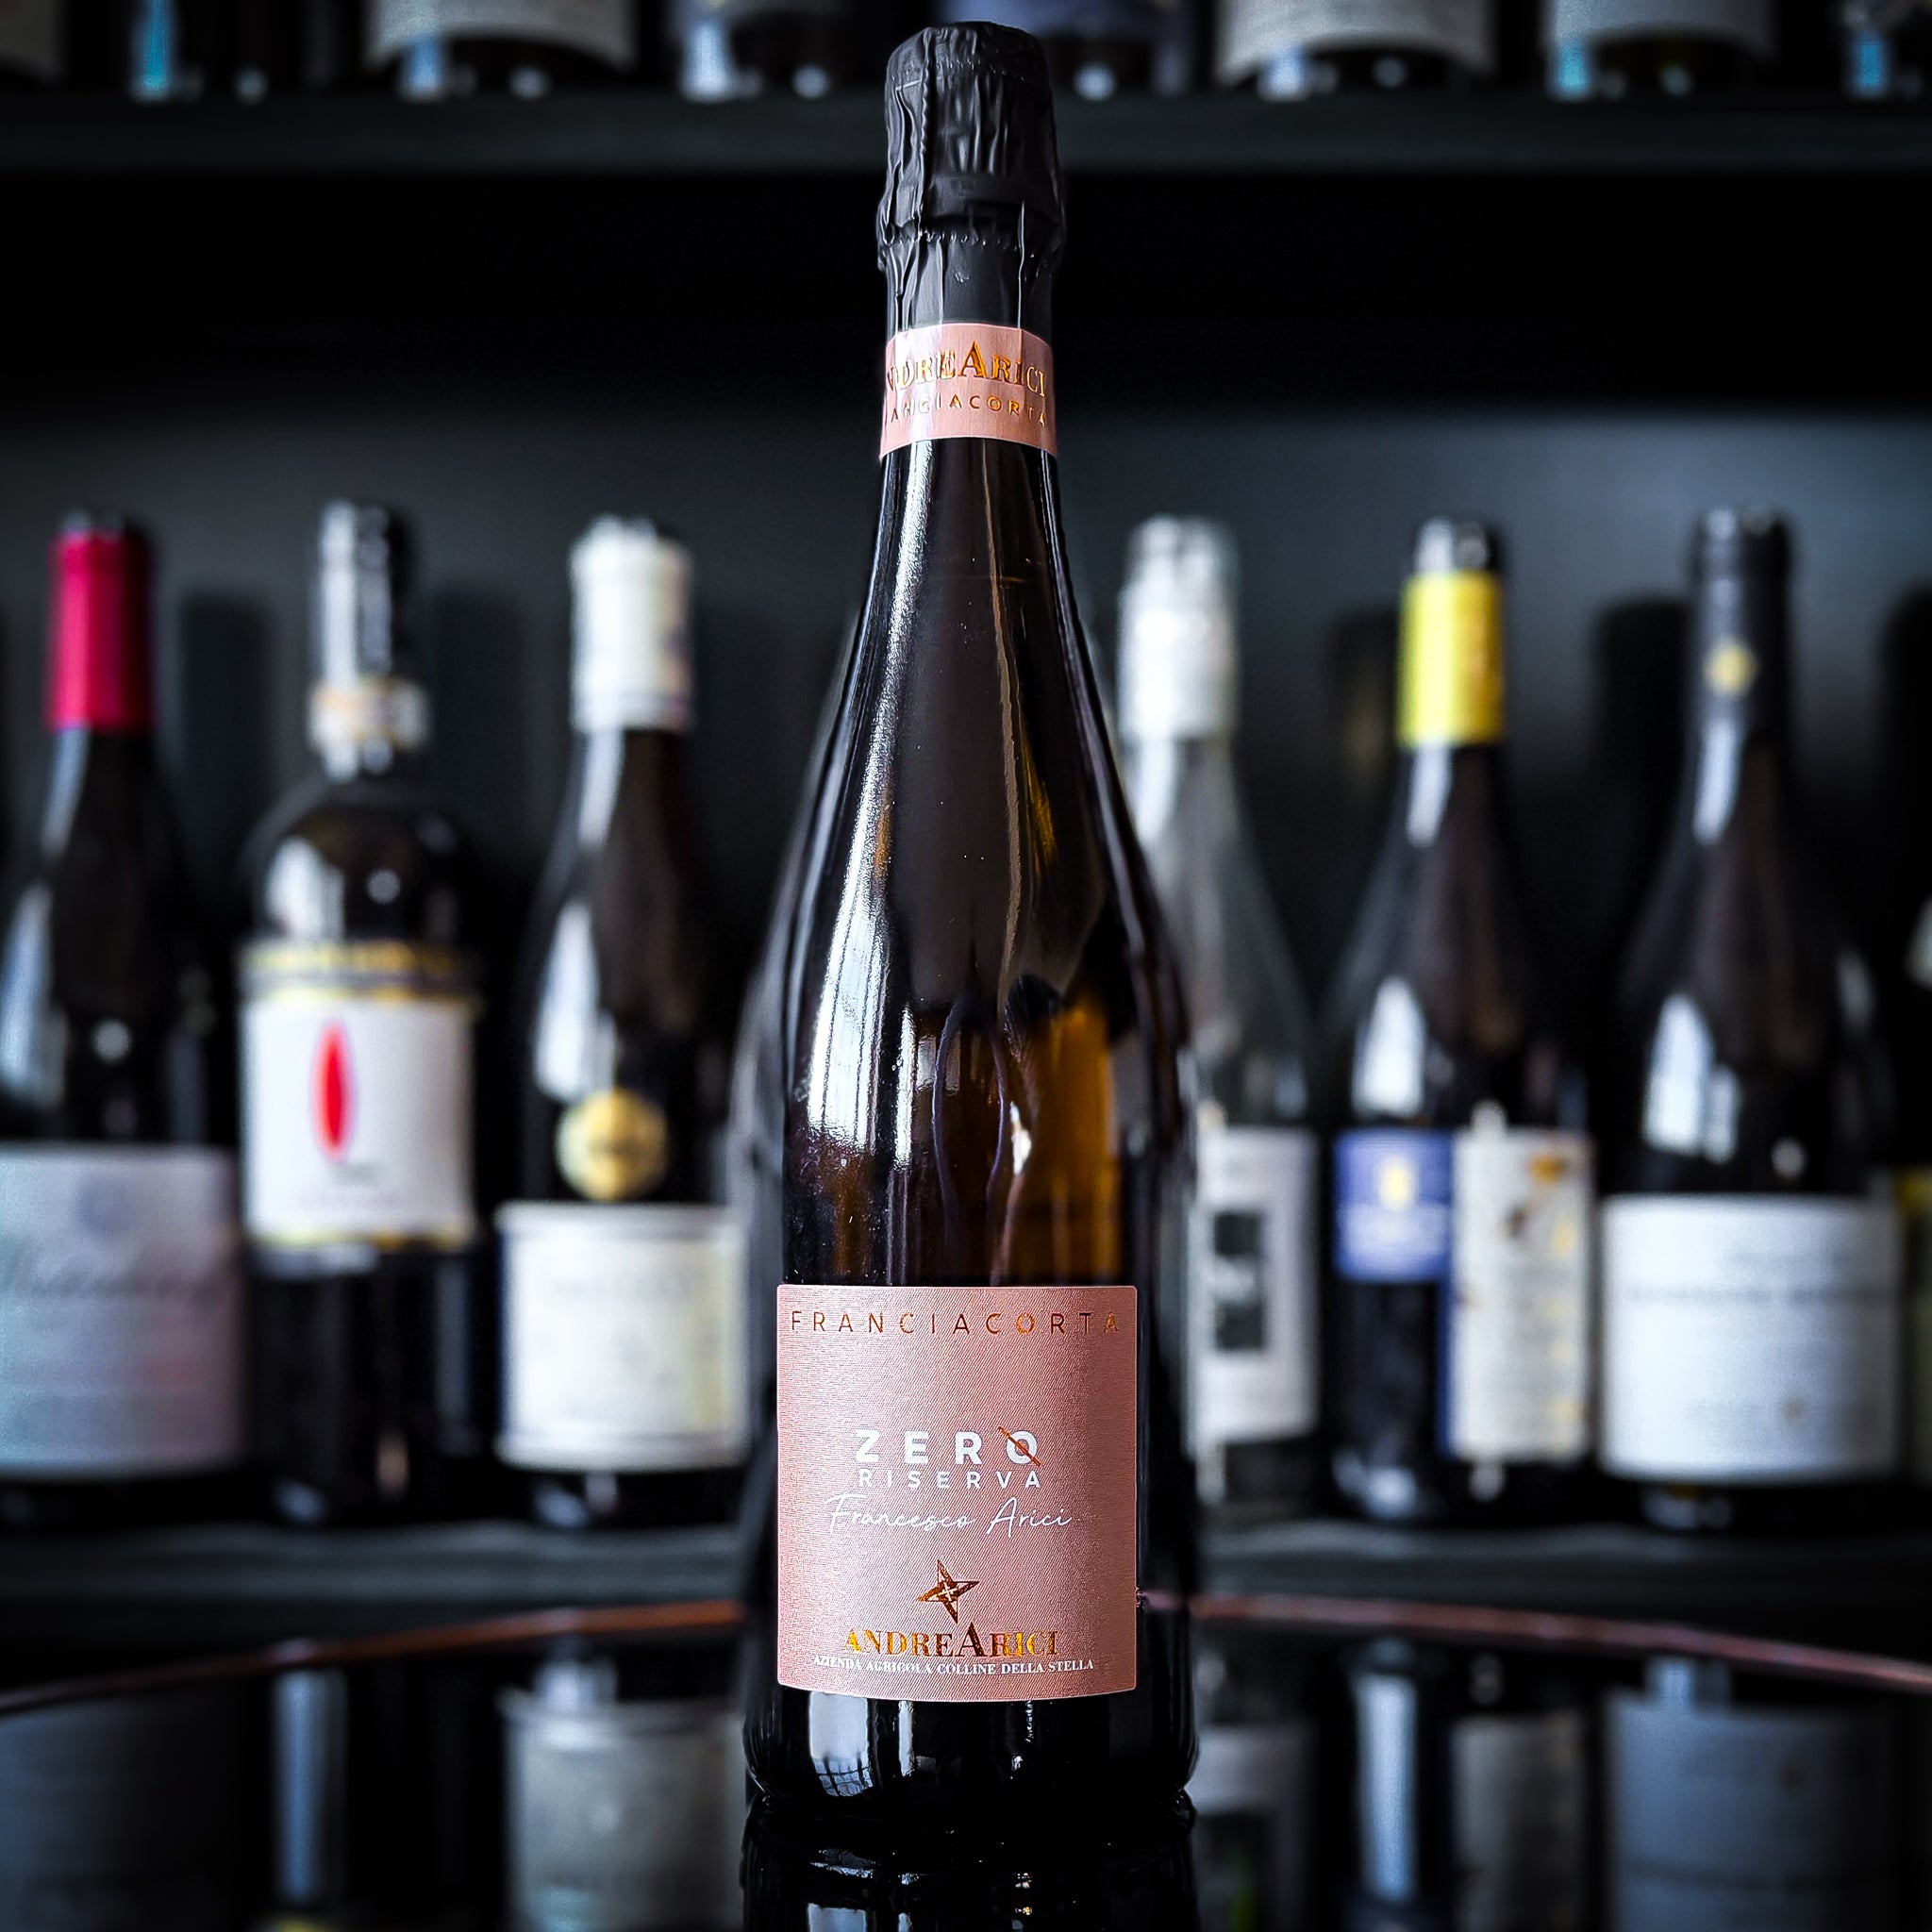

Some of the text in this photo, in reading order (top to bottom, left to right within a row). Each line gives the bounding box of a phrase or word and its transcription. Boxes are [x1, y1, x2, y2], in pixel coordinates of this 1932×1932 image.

[791, 1310, 1119, 1335] FRANCIACORTA
[854, 1426, 1042, 1467] ZERO
[858, 1471, 1041, 1489] RISERVA
[824, 1491, 1072, 1539] Francesco Arici
[842, 1622, 1058, 1657] ANDREARICI
[813, 1655, 1094, 1676] AZIENDA AGRICOLA COLLINE DELLA STELLA
